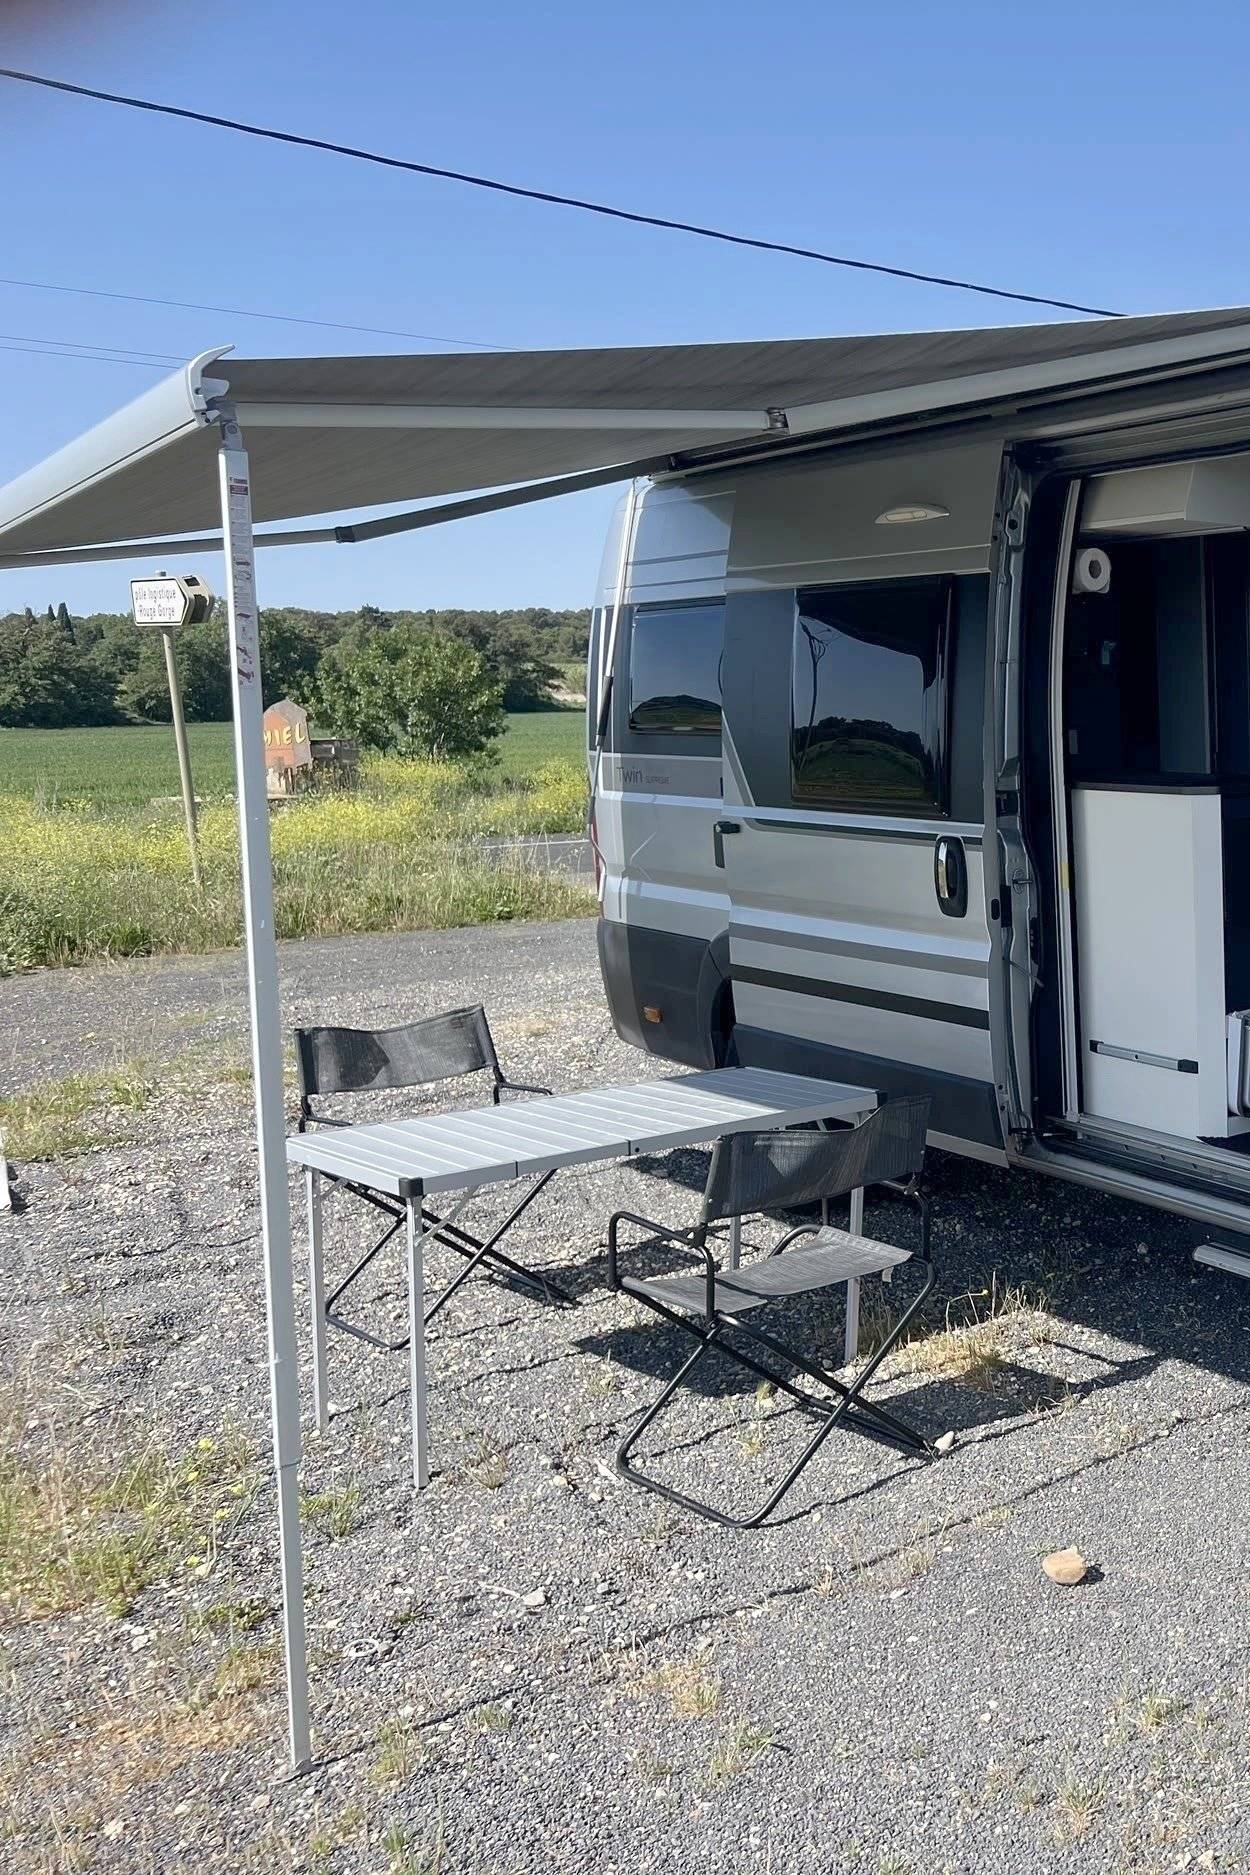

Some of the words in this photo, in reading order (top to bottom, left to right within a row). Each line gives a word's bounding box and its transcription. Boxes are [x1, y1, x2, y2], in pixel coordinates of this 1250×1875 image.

[148, 586, 176, 603] logistique
[158, 604, 175, 620] Gorge
[616, 766, 643, 784] Twin
